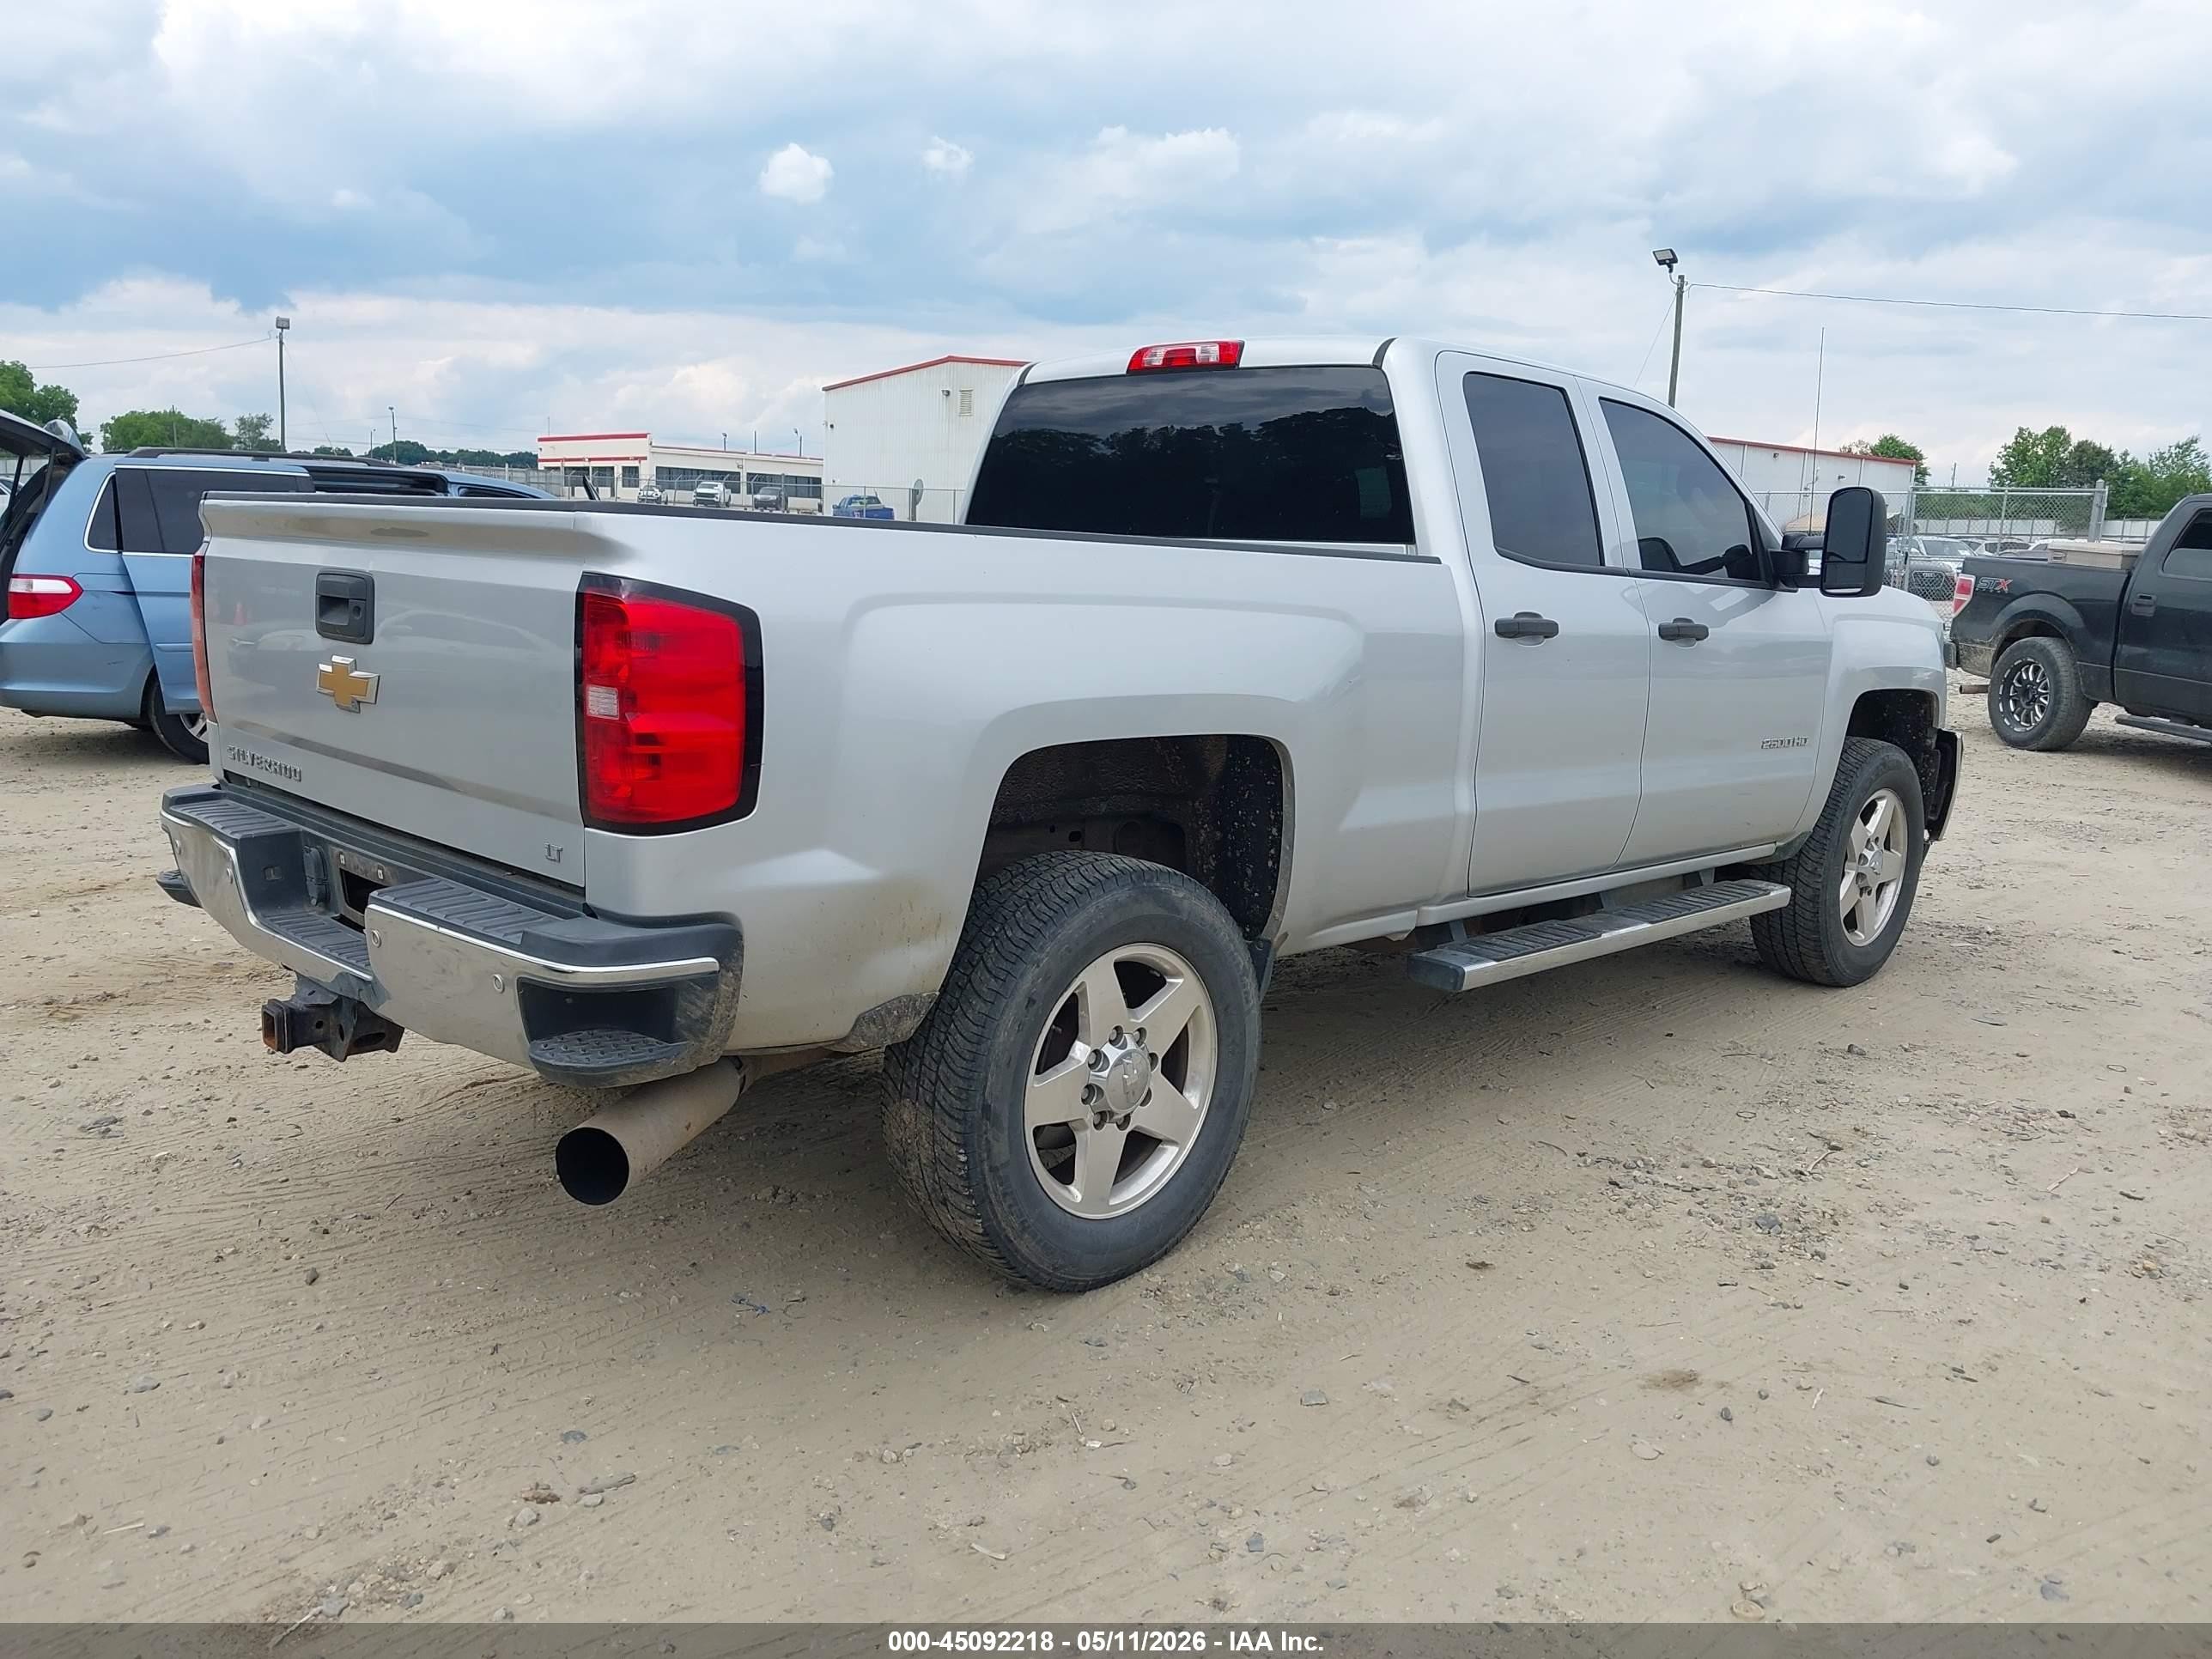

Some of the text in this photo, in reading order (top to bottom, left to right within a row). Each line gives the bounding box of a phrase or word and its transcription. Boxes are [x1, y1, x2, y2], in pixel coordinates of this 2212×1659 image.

[1977, 576, 2013, 592] STX
[227, 745, 301, 782] SILVERADO
[544, 842, 563, 864] LT
